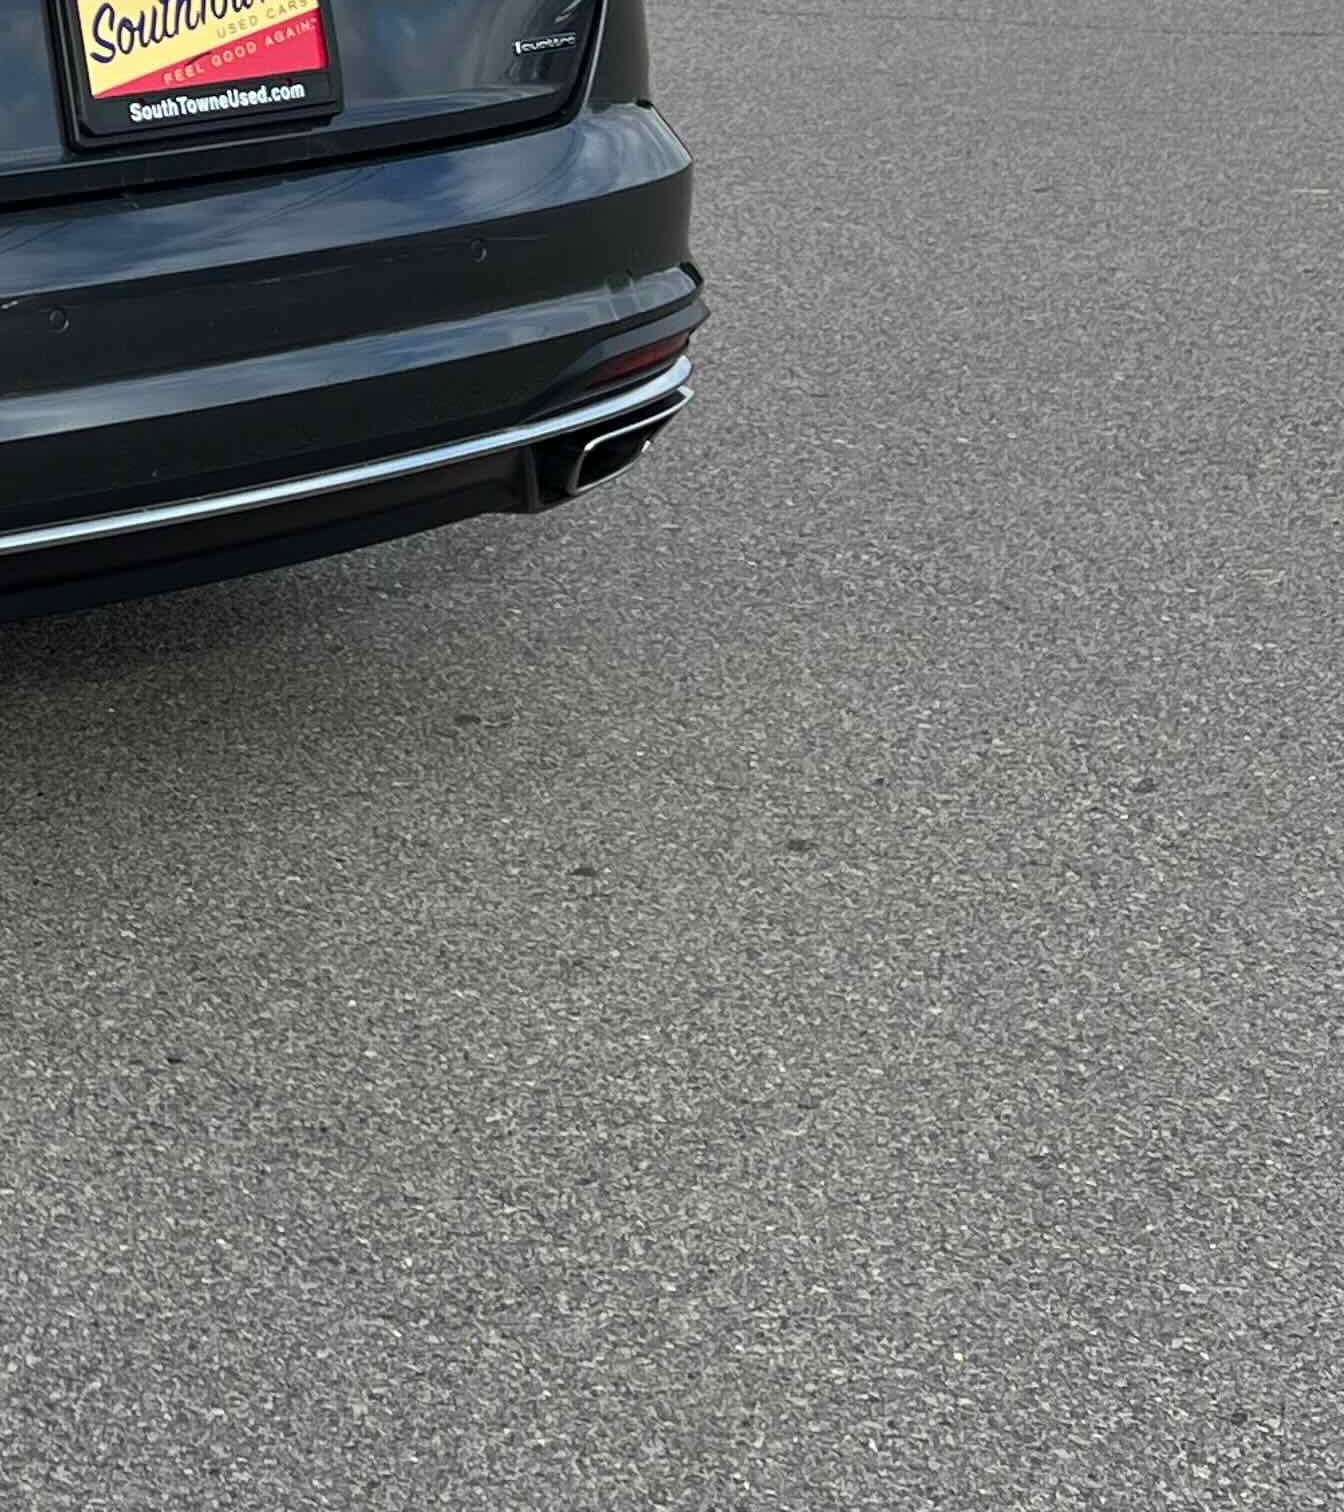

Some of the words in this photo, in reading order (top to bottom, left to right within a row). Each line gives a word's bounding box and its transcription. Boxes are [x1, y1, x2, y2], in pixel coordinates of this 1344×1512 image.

[216, 14, 259, 39] USED
[163, 63, 205, 87] FEEL
[212, 41, 257, 67] GOOD
[129, 83, 305, 123] SouthTowneUsed.com
